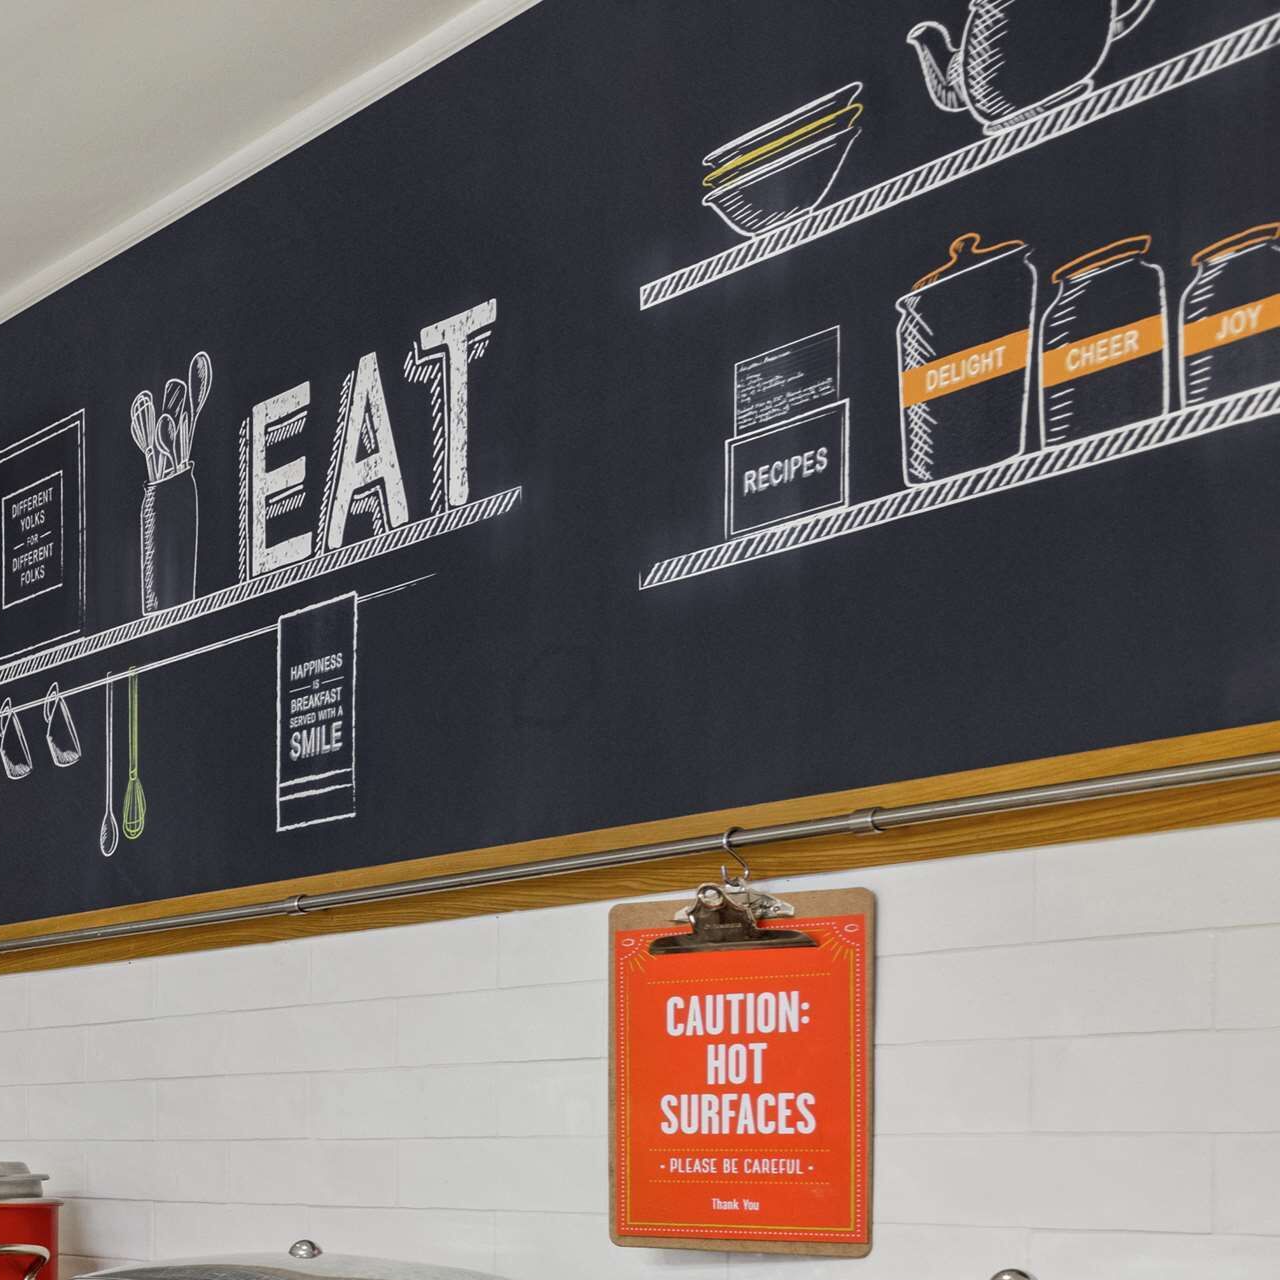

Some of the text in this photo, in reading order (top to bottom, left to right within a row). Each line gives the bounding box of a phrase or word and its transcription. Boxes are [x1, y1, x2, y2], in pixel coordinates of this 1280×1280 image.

[1216, 305, 1263, 341] JOY
[1065, 330, 1139, 371] CHEER
[925, 345, 1006, 391] DELIGHT
[240, 298, 497, 580] EAT
[744, 446, 828, 496] RECIPES
[11, 487, 54, 519] DIFFERENT
[20, 510, 45, 532] YOLKS
[27, 533, 39, 547] FOR
[12, 542, 54, 573] DIFFERENT
[20, 565, 45, 587] FOLKS
[290, 652, 343, 680] HAPPINESS
[312, 679, 320, 690] IS
[290, 687, 342, 714] BREAKFAST
[289, 705, 344, 729] SERVED WITH A
[289, 721, 343, 761] SMILE
[666, 991, 811, 1036] CAUTION:
[706, 1042, 768, 1085] HOT
[660, 1092, 817, 1136] SURFACES
[669, 1158, 804, 1175] PLEASE BE CAREFUL
[712, 1198, 760, 1211] Thank You
